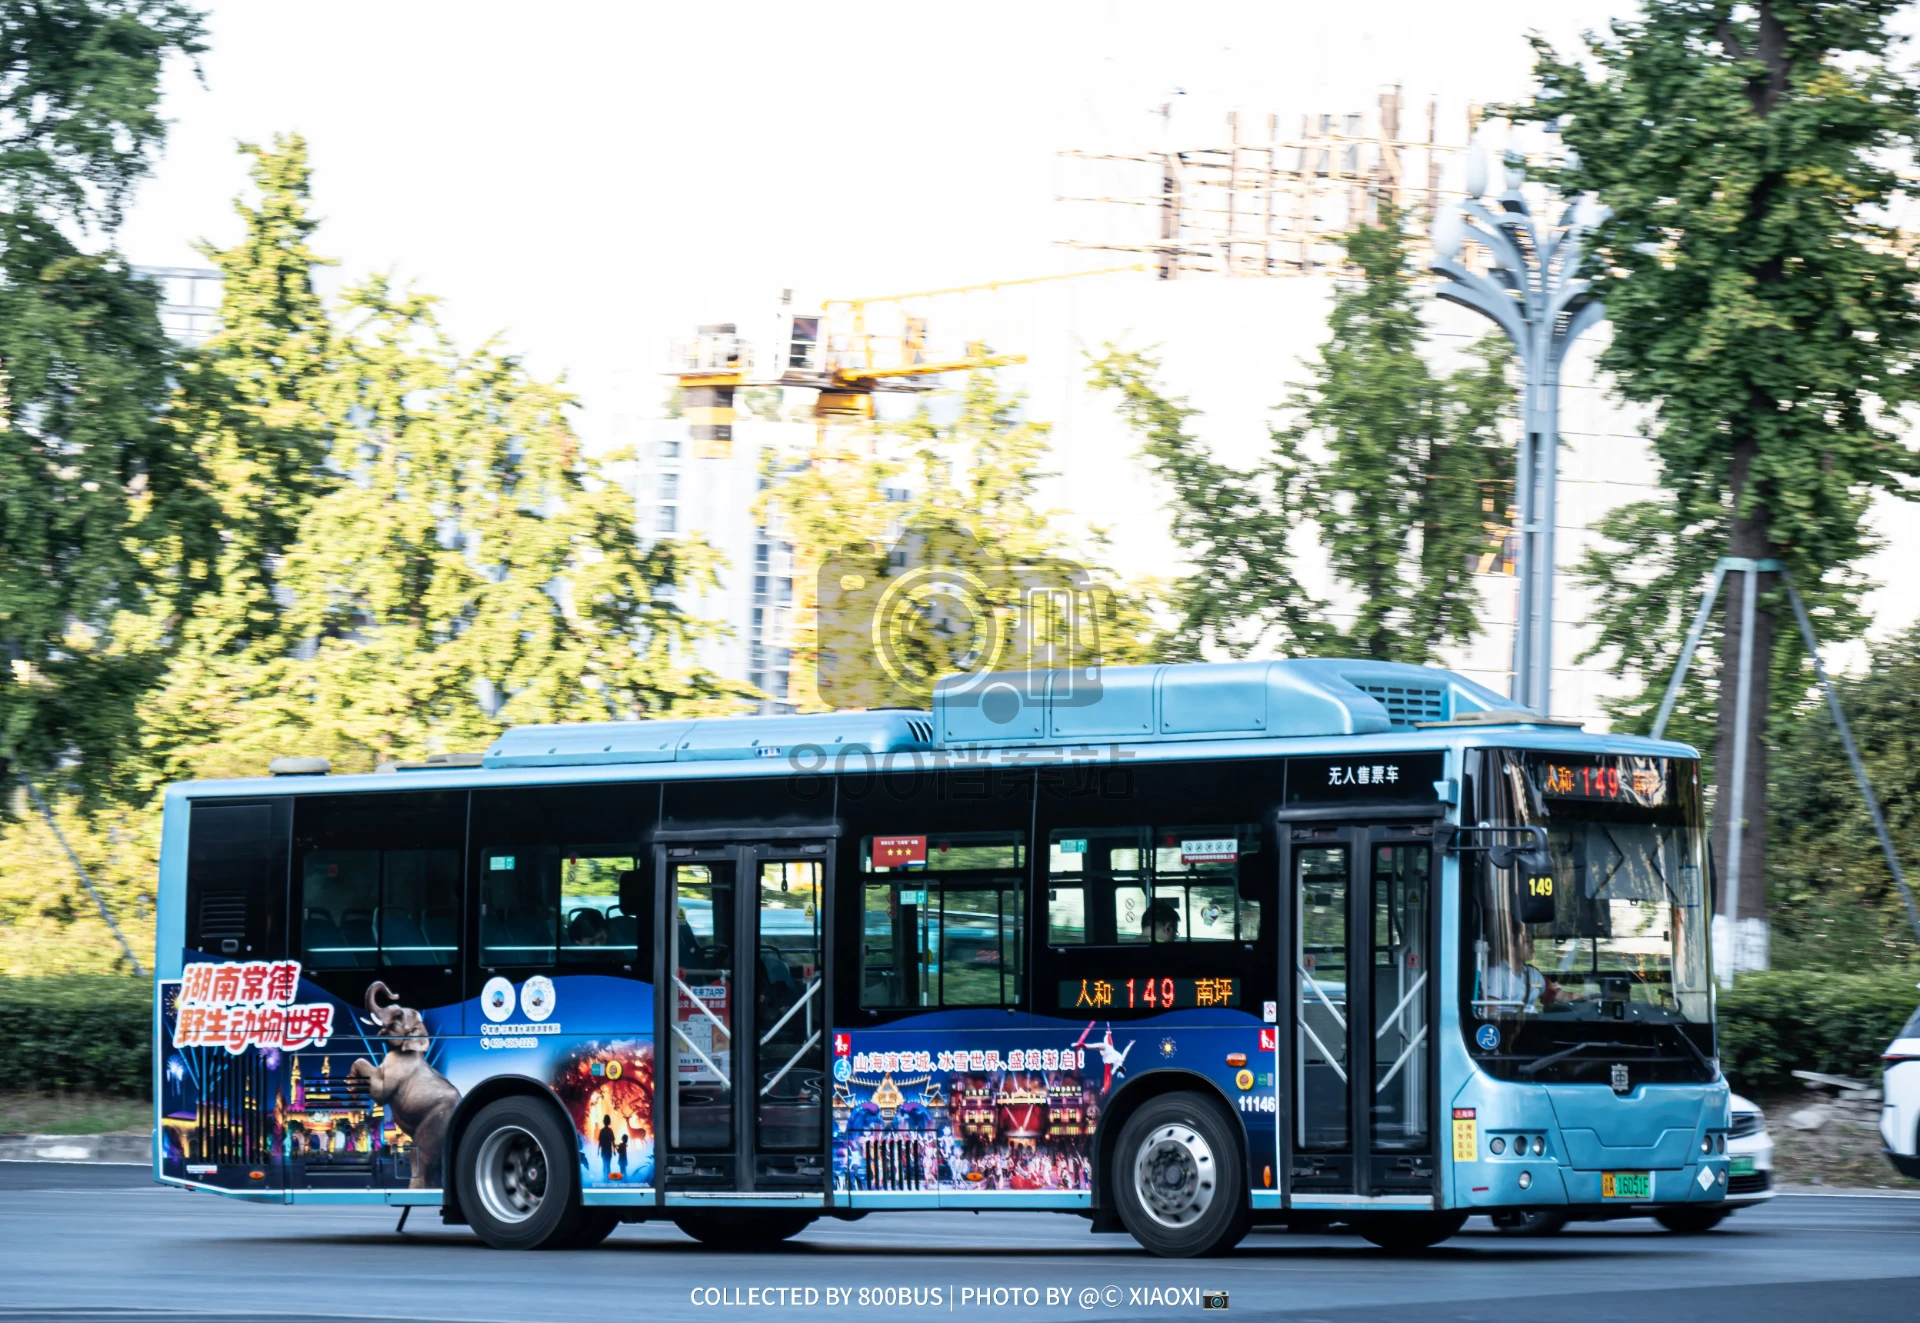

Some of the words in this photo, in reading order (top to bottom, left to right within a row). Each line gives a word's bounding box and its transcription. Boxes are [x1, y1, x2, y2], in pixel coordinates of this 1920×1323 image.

[1328, 765, 1399, 785] 无人售票车
[1582, 766, 1619, 798] 149
[1529, 877, 1553, 896] 149
[180, 962, 299, 1003] 湖南常德
[1075, 978, 1114, 1008] 人和
[1125, 977, 1175, 1009] 149
[1194, 977, 1234, 1007] 南坪
[175, 1005, 331, 1052] 野生动物世界
[1238, 1095, 1276, 1113] 11146
